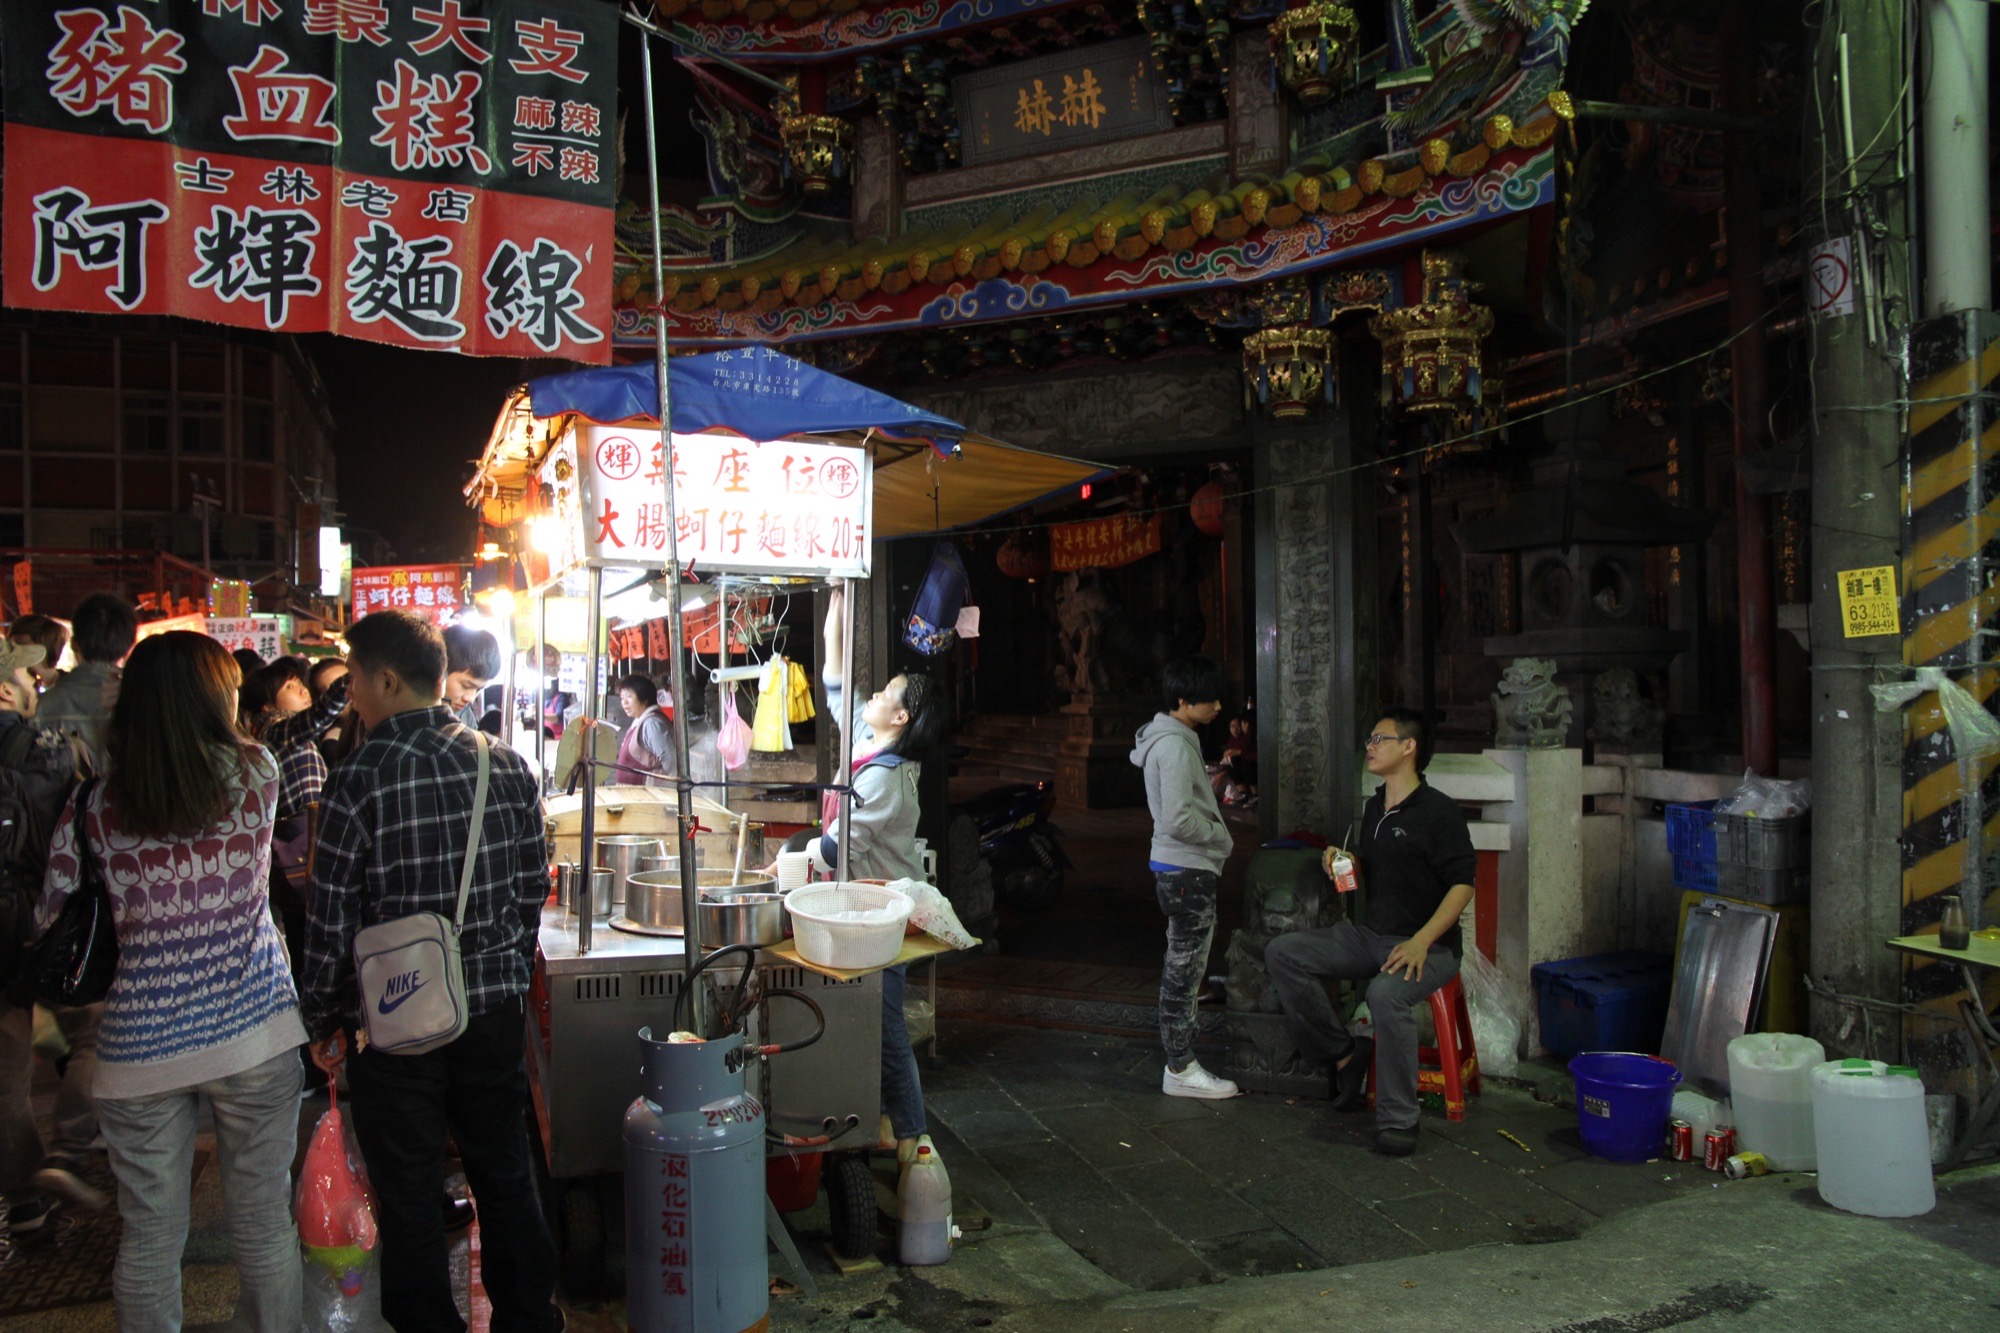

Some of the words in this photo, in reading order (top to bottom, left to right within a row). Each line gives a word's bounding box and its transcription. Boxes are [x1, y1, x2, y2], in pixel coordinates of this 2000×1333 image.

[46, 6, 492, 175] 豬血糕
[513, 95, 601, 137] 麻辣
[174, 158, 474, 224] 士林老店
[511, 142, 600, 184] 不辣
[31, 186, 605, 352] 阿輝麵線
[385, 969, 421, 998] NIKE
[660, 1152, 688, 1296] 液化石油氣
